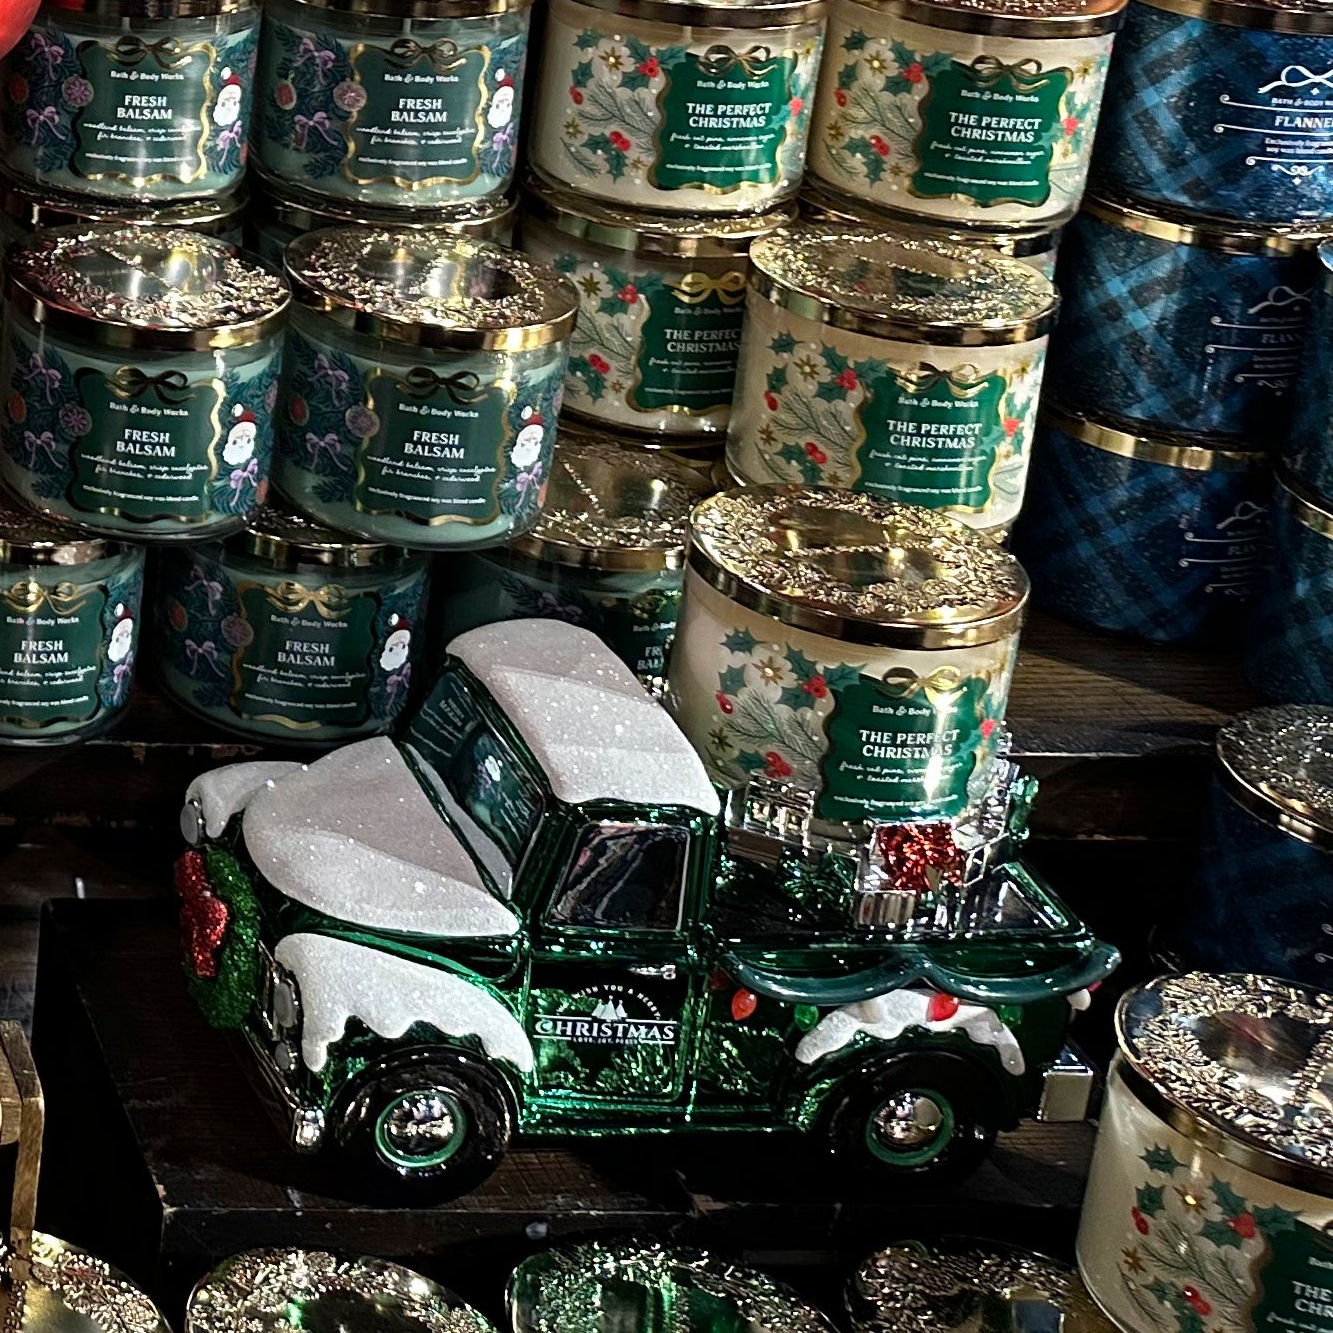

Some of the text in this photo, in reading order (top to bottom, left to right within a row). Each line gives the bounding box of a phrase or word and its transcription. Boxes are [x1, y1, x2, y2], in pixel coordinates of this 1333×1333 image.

[124, 95, 167, 107] FRESH
[399, 98, 442, 111] FRESH
[117, 108, 173, 120] BALSAM
[686, 102, 772, 116] THE PERFECT
[391, 111, 448, 123] BALSAM
[689, 116, 766, 129] CHRISTMAS
[949, 112, 1041, 130] THE PERFECT
[1275, 116, 1333, 128] FLANNE
[950, 126, 1035, 143] CHRISTMAS
[664, 329, 740, 340] THE PERFEC
[887, 419, 982, 435] THE PERFECT
[124, 428, 169, 444] FRESH
[413, 430, 459, 445] FRESH
[889, 434, 976, 449] CHRISTMAS
[116, 441, 176, 458] BALSAM
[404, 443, 465, 459] BALSAM
[21, 640, 63, 651] FRESH
[285, 640, 330, 654] FRESH
[13, 652, 69, 664] BALSAM
[277, 652, 335, 667] BALSAM
[859, 729, 894, 744] THE
[535, 1019, 675, 1040] CHRISTMAS
[1291, 1280, 1332, 1302] THE
